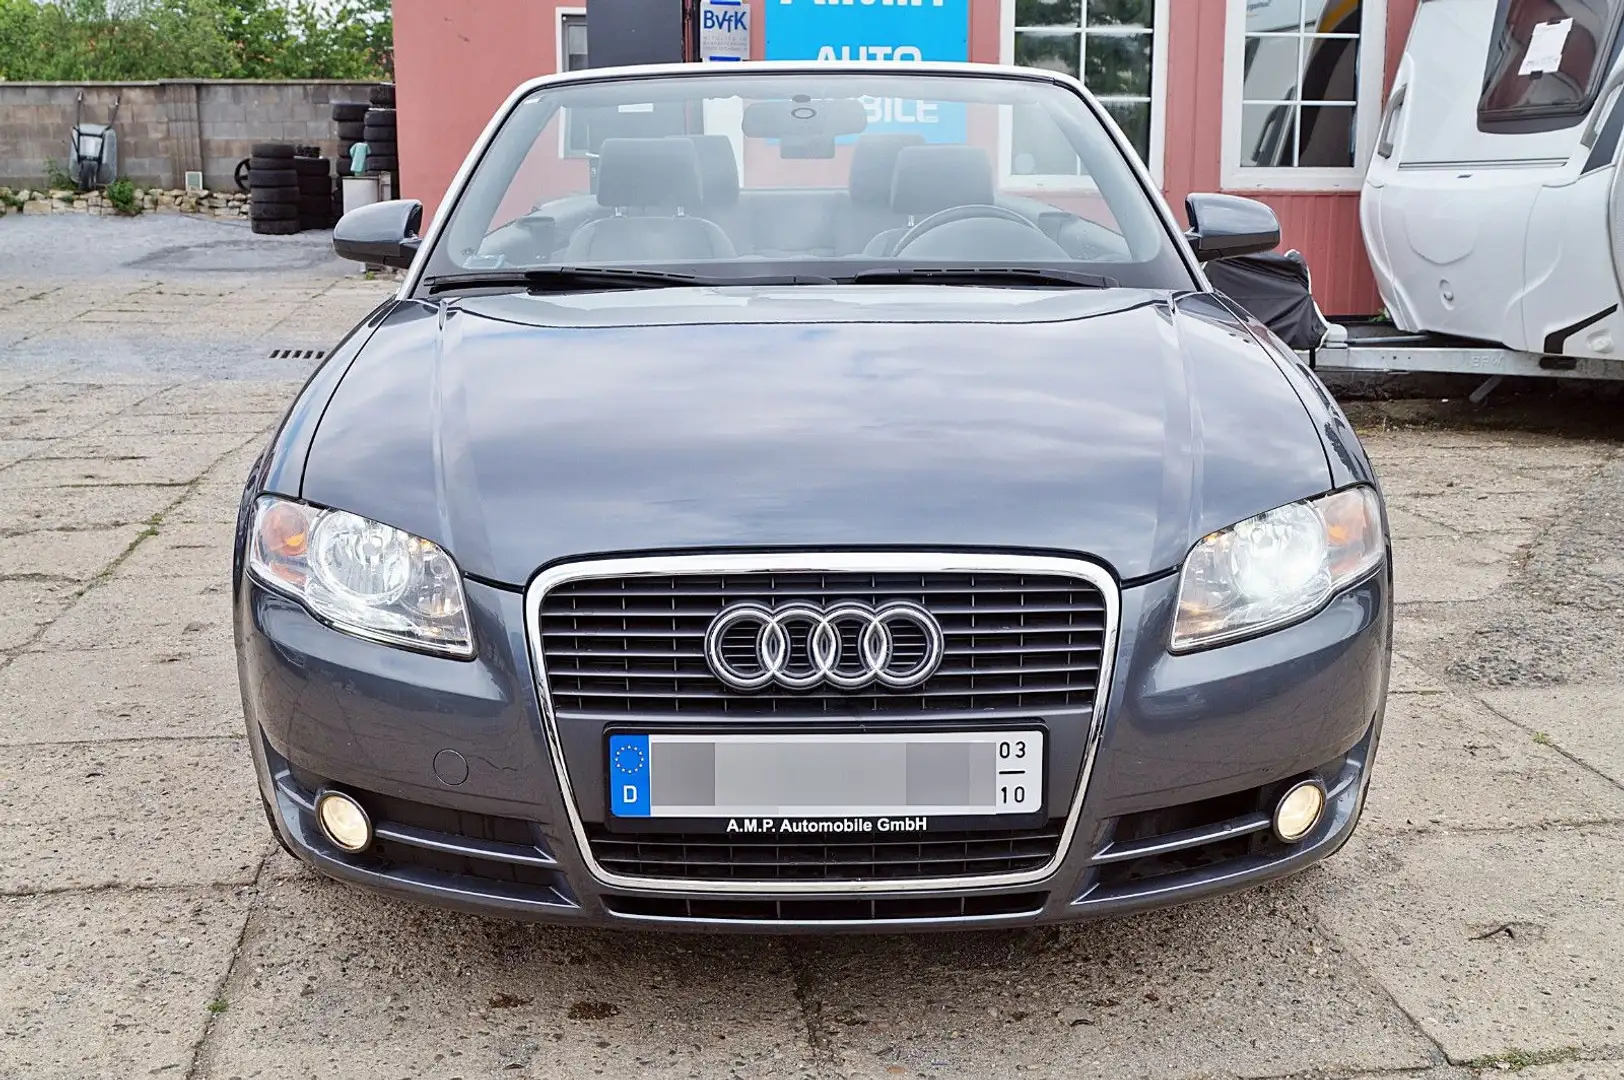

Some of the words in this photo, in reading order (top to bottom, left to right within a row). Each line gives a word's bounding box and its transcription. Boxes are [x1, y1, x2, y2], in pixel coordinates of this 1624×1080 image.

[703, 10, 748, 33] BVfK
[816, 46, 923, 61] AUTO
[858, 95, 939, 123] BILE
[999, 741, 1026, 758] 03
[623, 785, 637, 803] D
[1001, 786, 1025, 803] 10
[726, 818, 777, 833] A.M.P.
[780, 818, 873, 833] Automobile
[876, 817, 927, 832] GmbH
